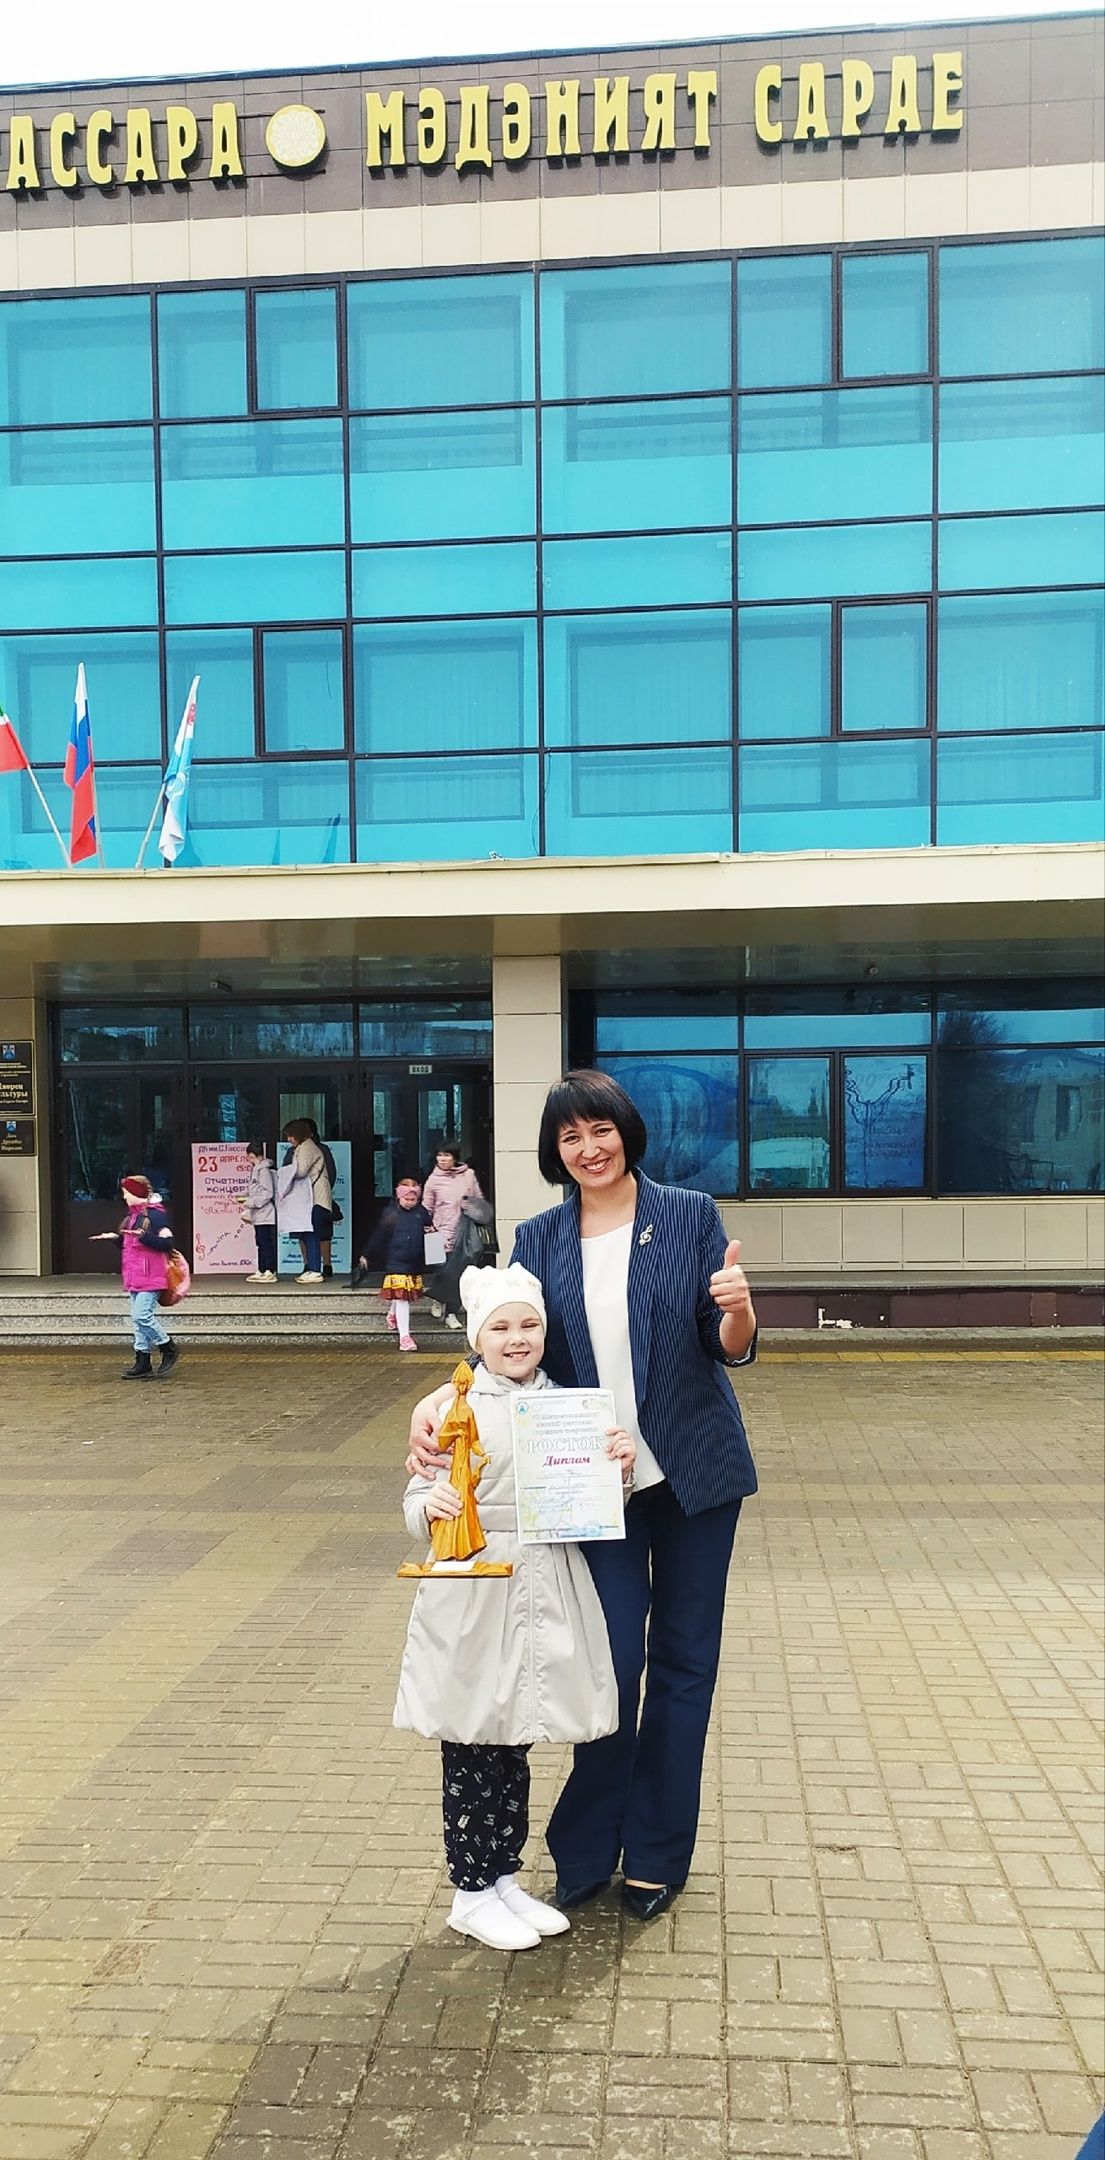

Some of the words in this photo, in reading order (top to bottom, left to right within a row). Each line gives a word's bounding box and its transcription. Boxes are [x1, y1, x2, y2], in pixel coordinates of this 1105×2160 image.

[366, 70, 718, 172] МӘДӘНИЯТ
[755, 52, 963, 143] САРАЕ
[198, 1156, 218, 1172] 23
[527, 1435, 605, 1453] РОСТОК
[542, 1455, 591, 1467] Диплом
